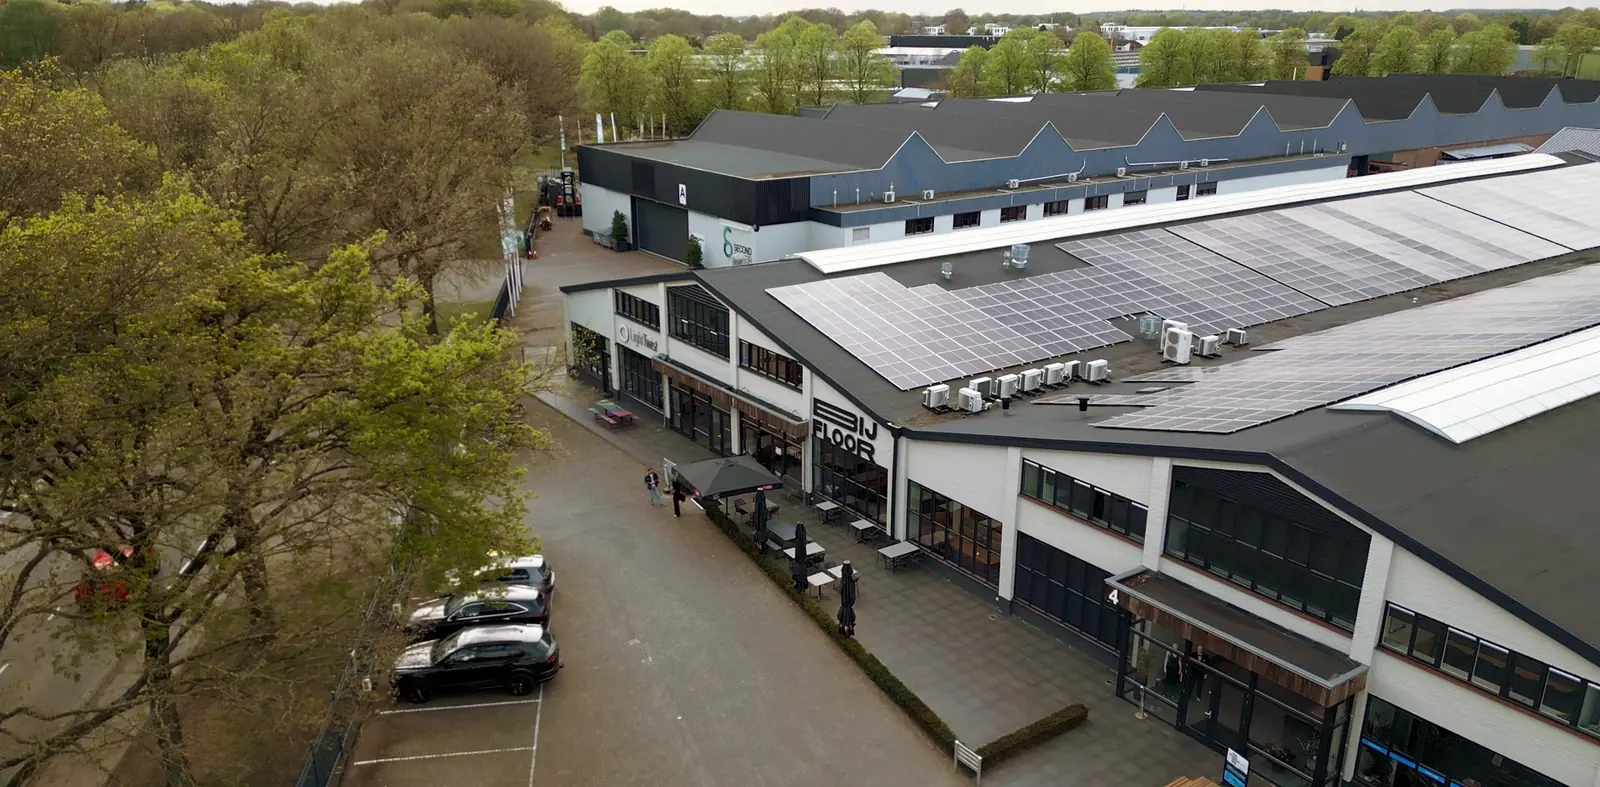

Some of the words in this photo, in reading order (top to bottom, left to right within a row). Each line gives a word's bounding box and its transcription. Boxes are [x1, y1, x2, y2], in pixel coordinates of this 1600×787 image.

[680, 187, 686, 198] A
[733, 243, 753, 256] SECOND
[813, 397, 878, 440] BIJ
[812, 418, 876, 465] FLOOR
[1108, 589, 1119, 605] 4
